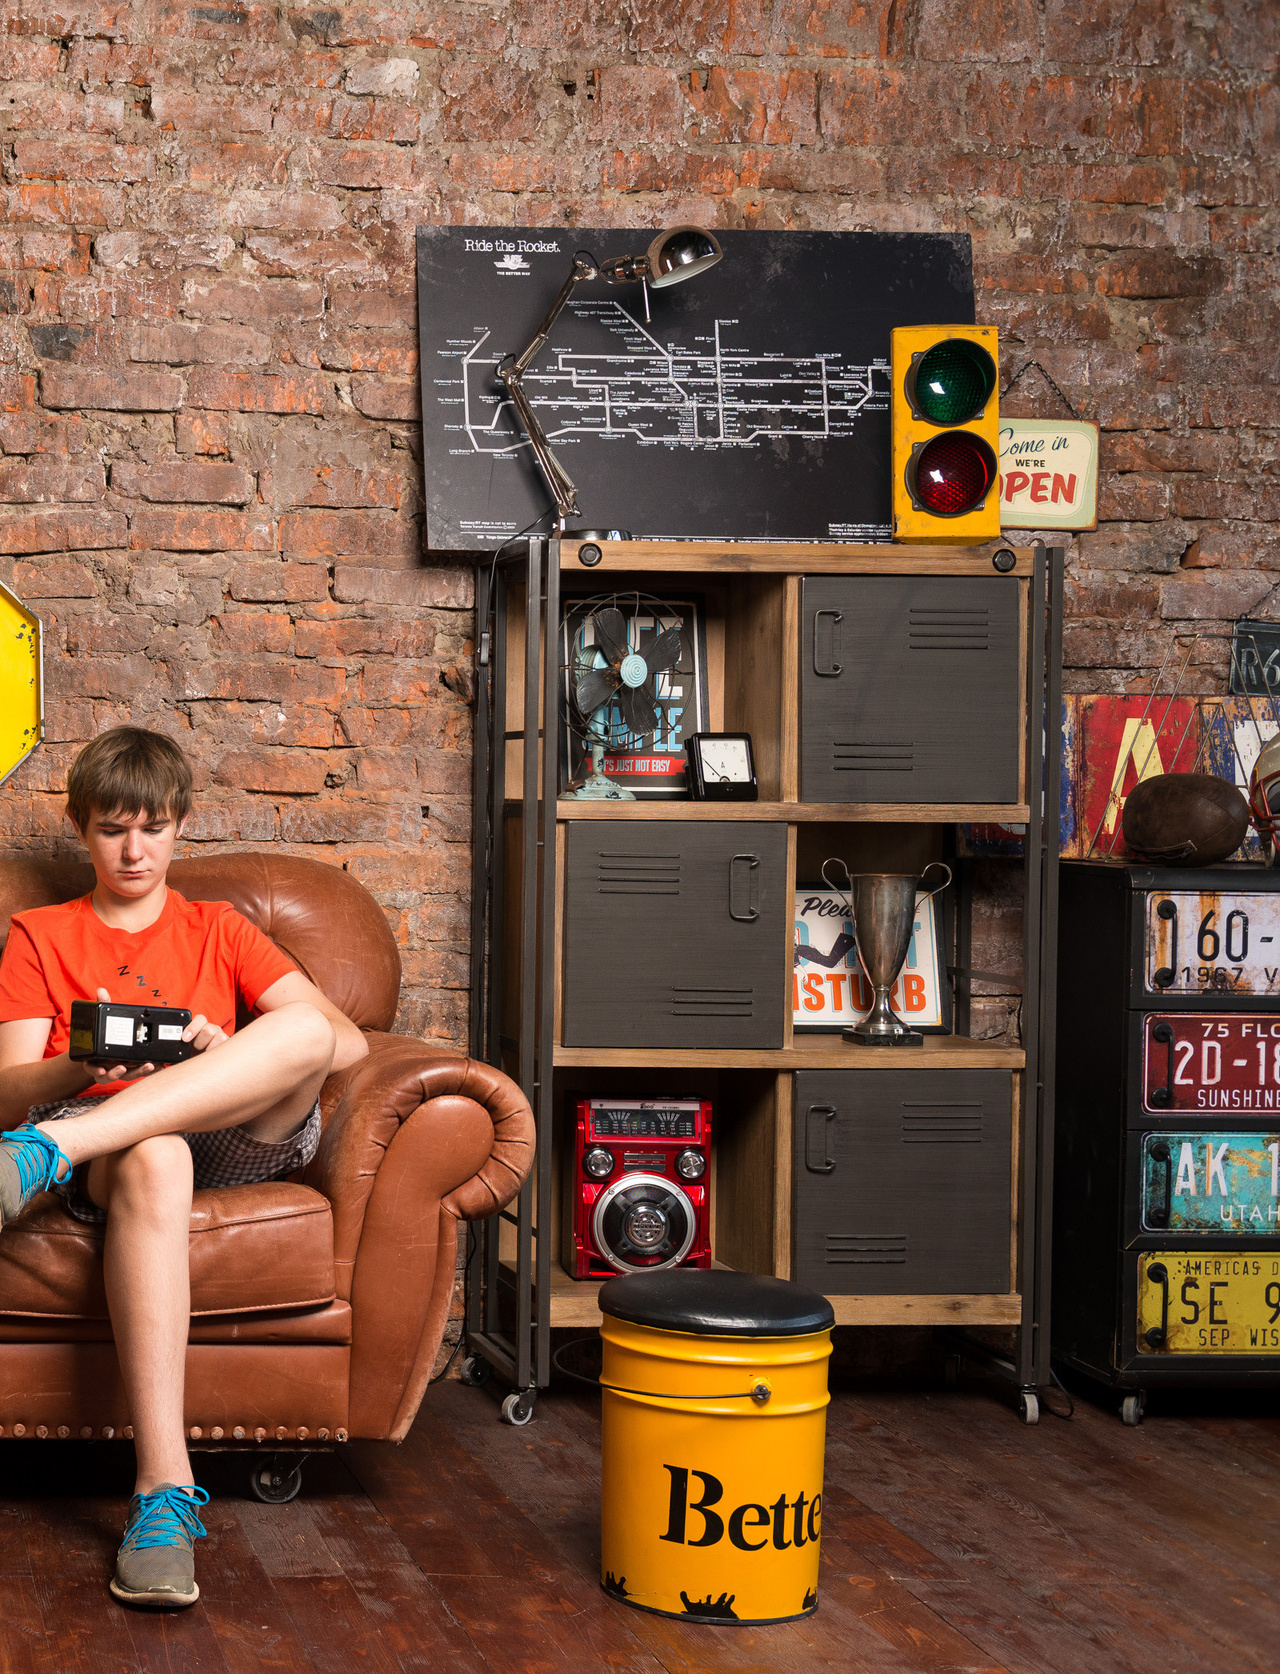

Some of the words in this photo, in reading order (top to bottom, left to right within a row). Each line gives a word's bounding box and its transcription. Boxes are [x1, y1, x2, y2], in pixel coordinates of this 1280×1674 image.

[465, 240, 493, 252] Ride
[495, 240, 515, 252] the
[517, 240, 560, 252] Rocket.
[999, 428, 1046, 458] Come
[1052, 436, 1068, 451] in
[1015, 458, 1046, 468] WE'RE
[1000, 471, 1077, 504] PEN
[615, 760, 632, 772] JUST
[635, 760, 648, 772] NOT
[652, 760, 670, 772] EASY
[800, 896, 852, 918] Plea
[794, 973, 926, 1012] ISTURB
[1202, 1022, 1229, 1038] 75
[1174, 1142, 1229, 1196] AK
[1186, 1260, 1260, 1276] AMERICAS
[1181, 1282, 1228, 1325] SE
[1199, 1328, 1236, 1346] SEP.
